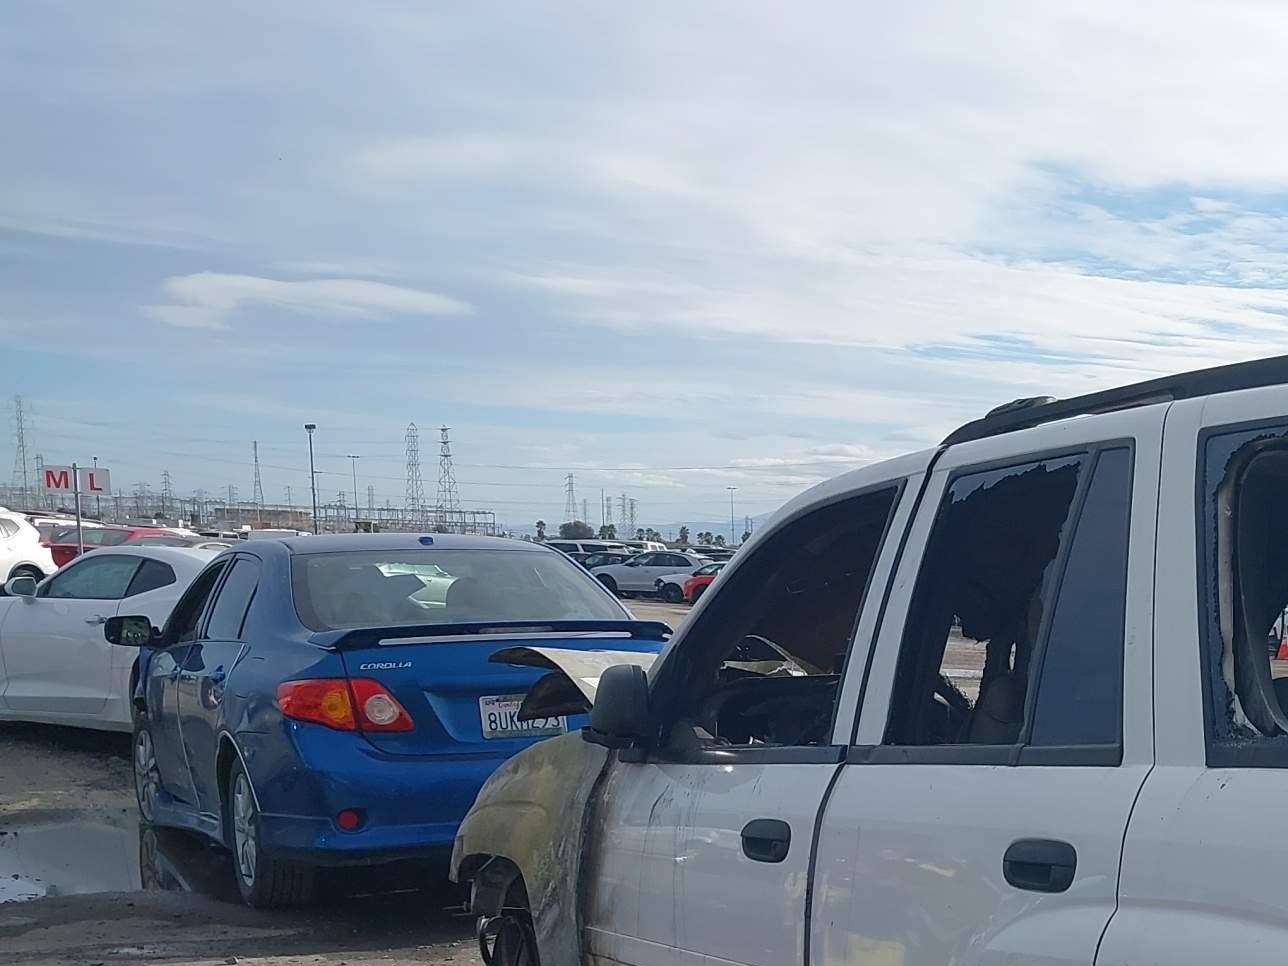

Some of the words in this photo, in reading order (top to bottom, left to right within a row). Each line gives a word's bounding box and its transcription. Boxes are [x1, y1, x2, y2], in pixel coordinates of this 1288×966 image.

[45, 470, 69, 489] M
[88, 473, 103, 491] L
[359, 661, 412, 670] COROLLA
